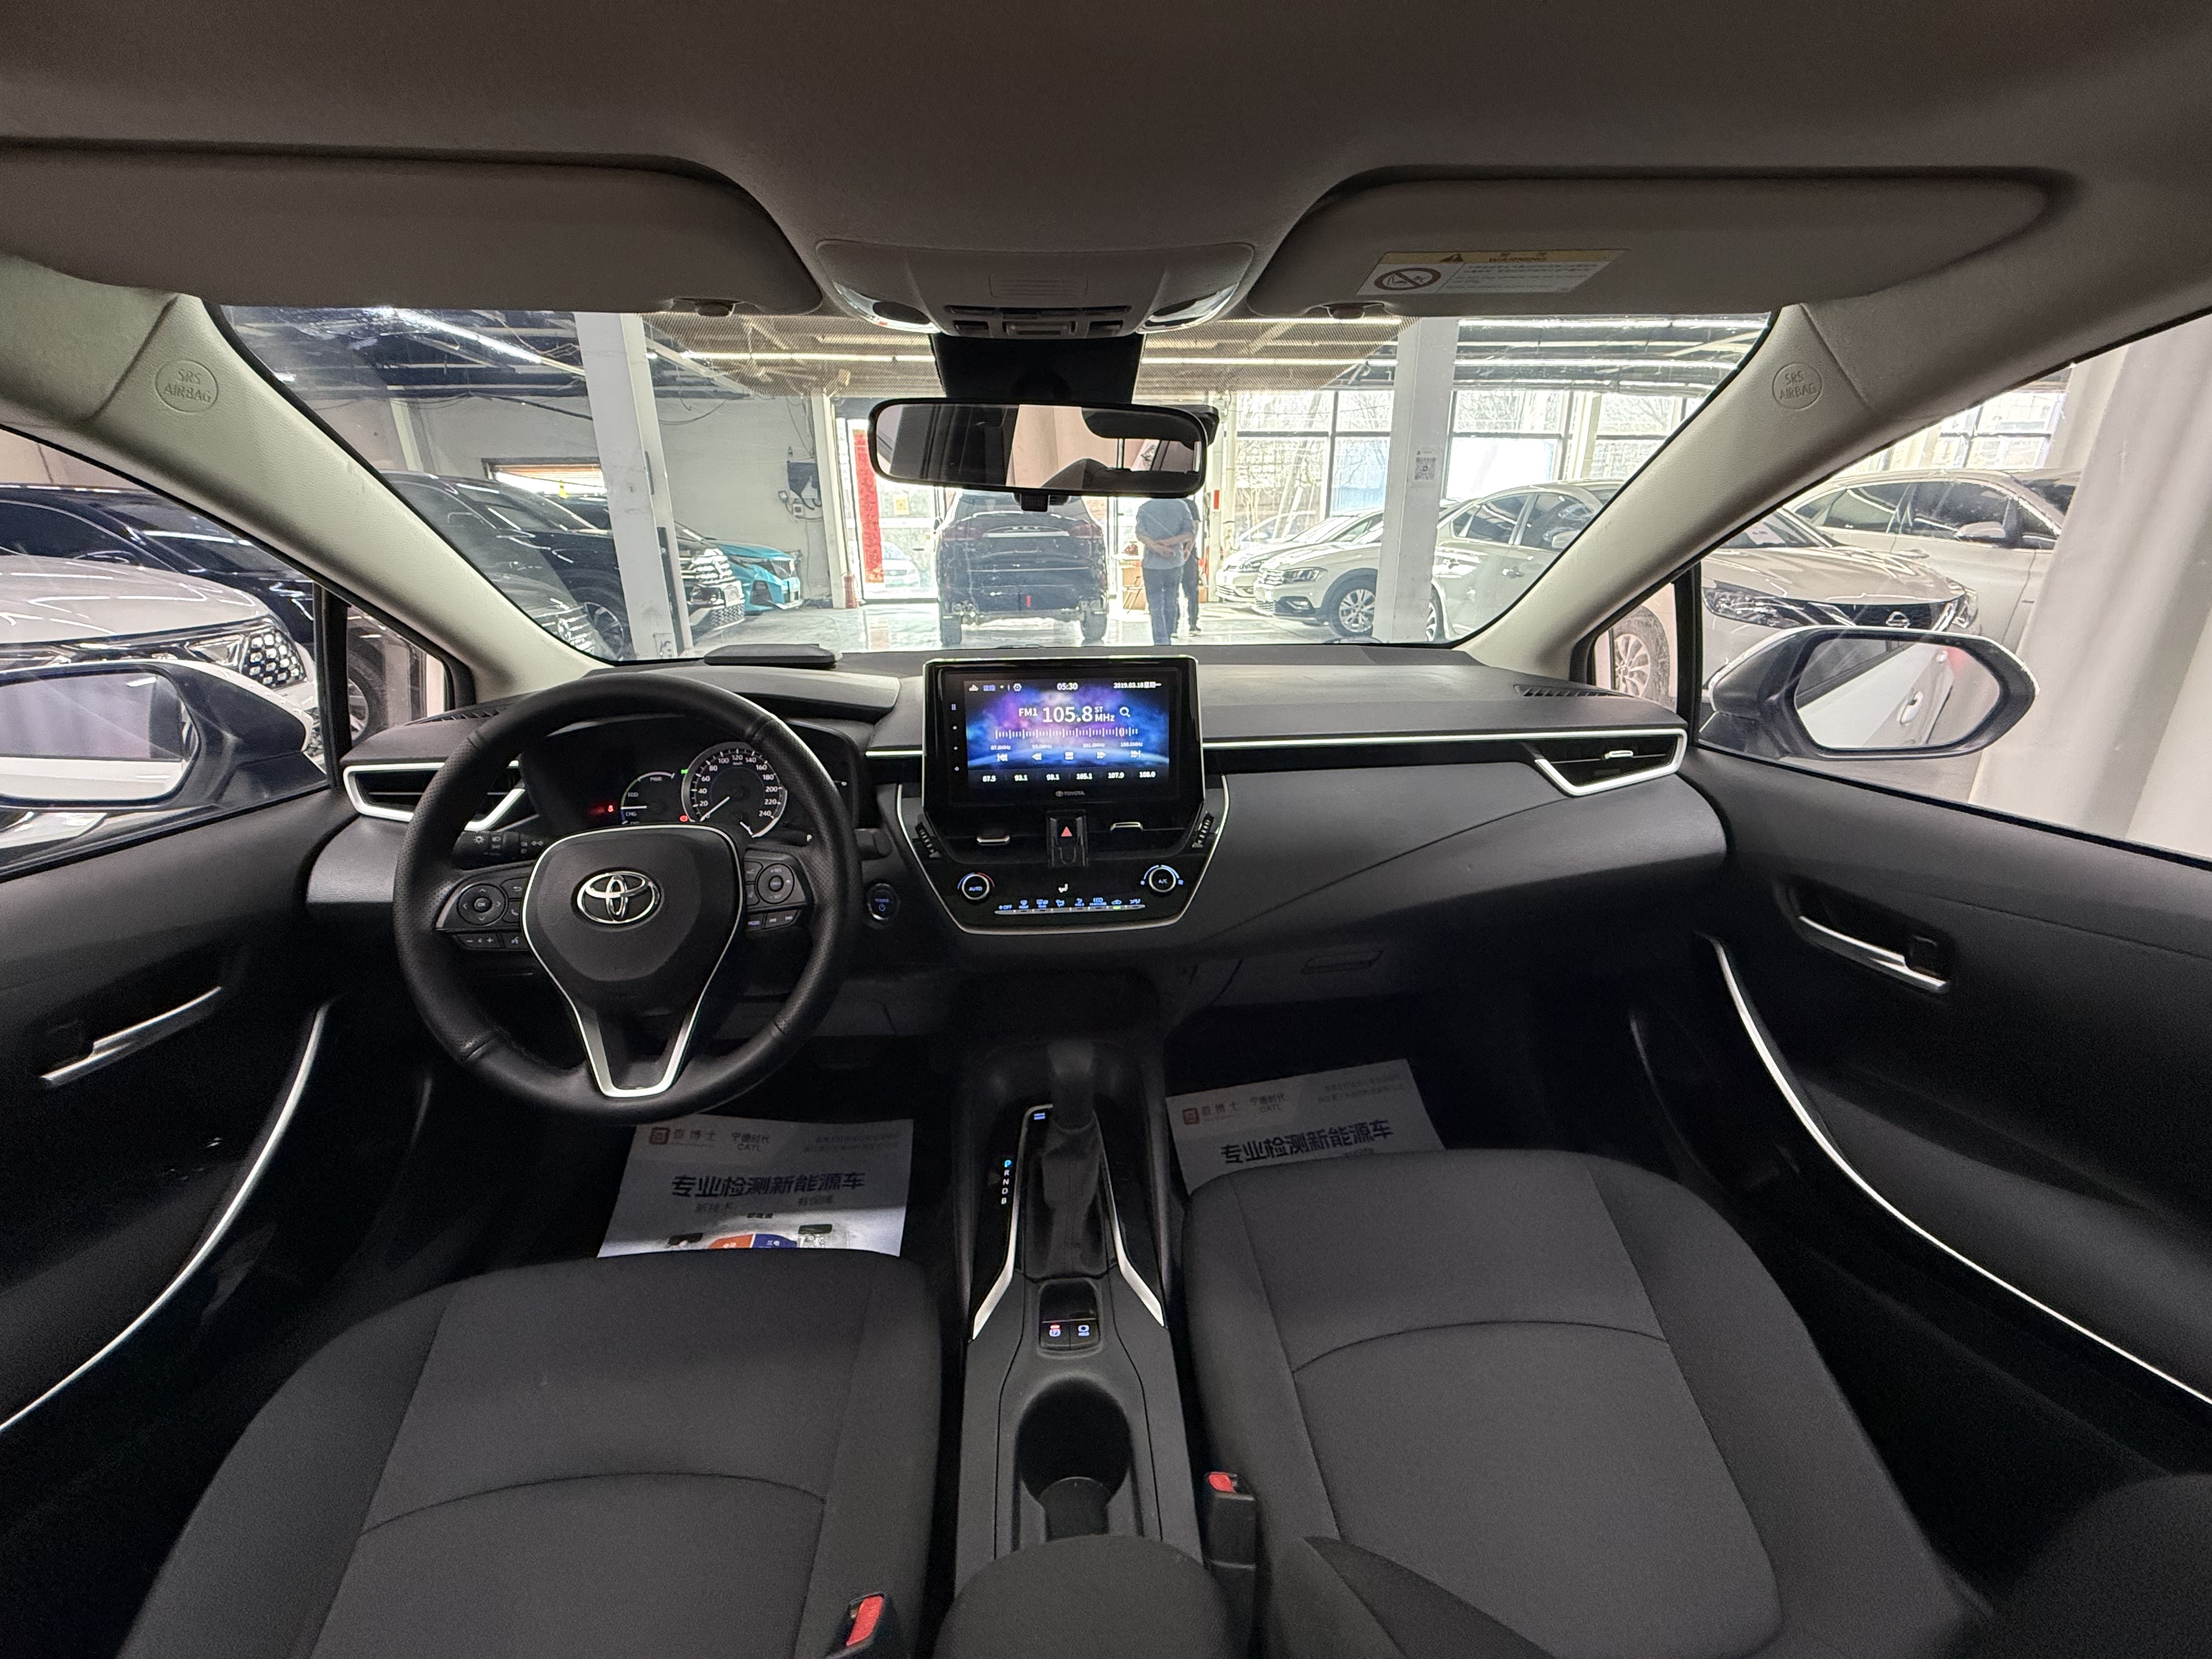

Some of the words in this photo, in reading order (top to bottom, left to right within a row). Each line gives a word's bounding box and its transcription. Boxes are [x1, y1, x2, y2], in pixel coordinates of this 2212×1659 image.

[177, 369, 202, 385] SRS
[1785, 371, 1804, 385] SRS
[164, 383, 211, 403] AIRBAG
[1779, 383, 1817, 400] AIRBAG
[1057, 682, 1078, 691] 05:30
[1018, 708, 1038, 716] FM1
[1042, 706, 1093, 723] 105.8
[1094, 713, 1115, 722] MHz
[1260, 1104, 1282, 1114] CATL
[737, 1143, 762, 1152] CATL
[1221, 1119, 1394, 1164] 专业检测新能源车
[671, 1171, 866, 1198] 专业检测新能源车
